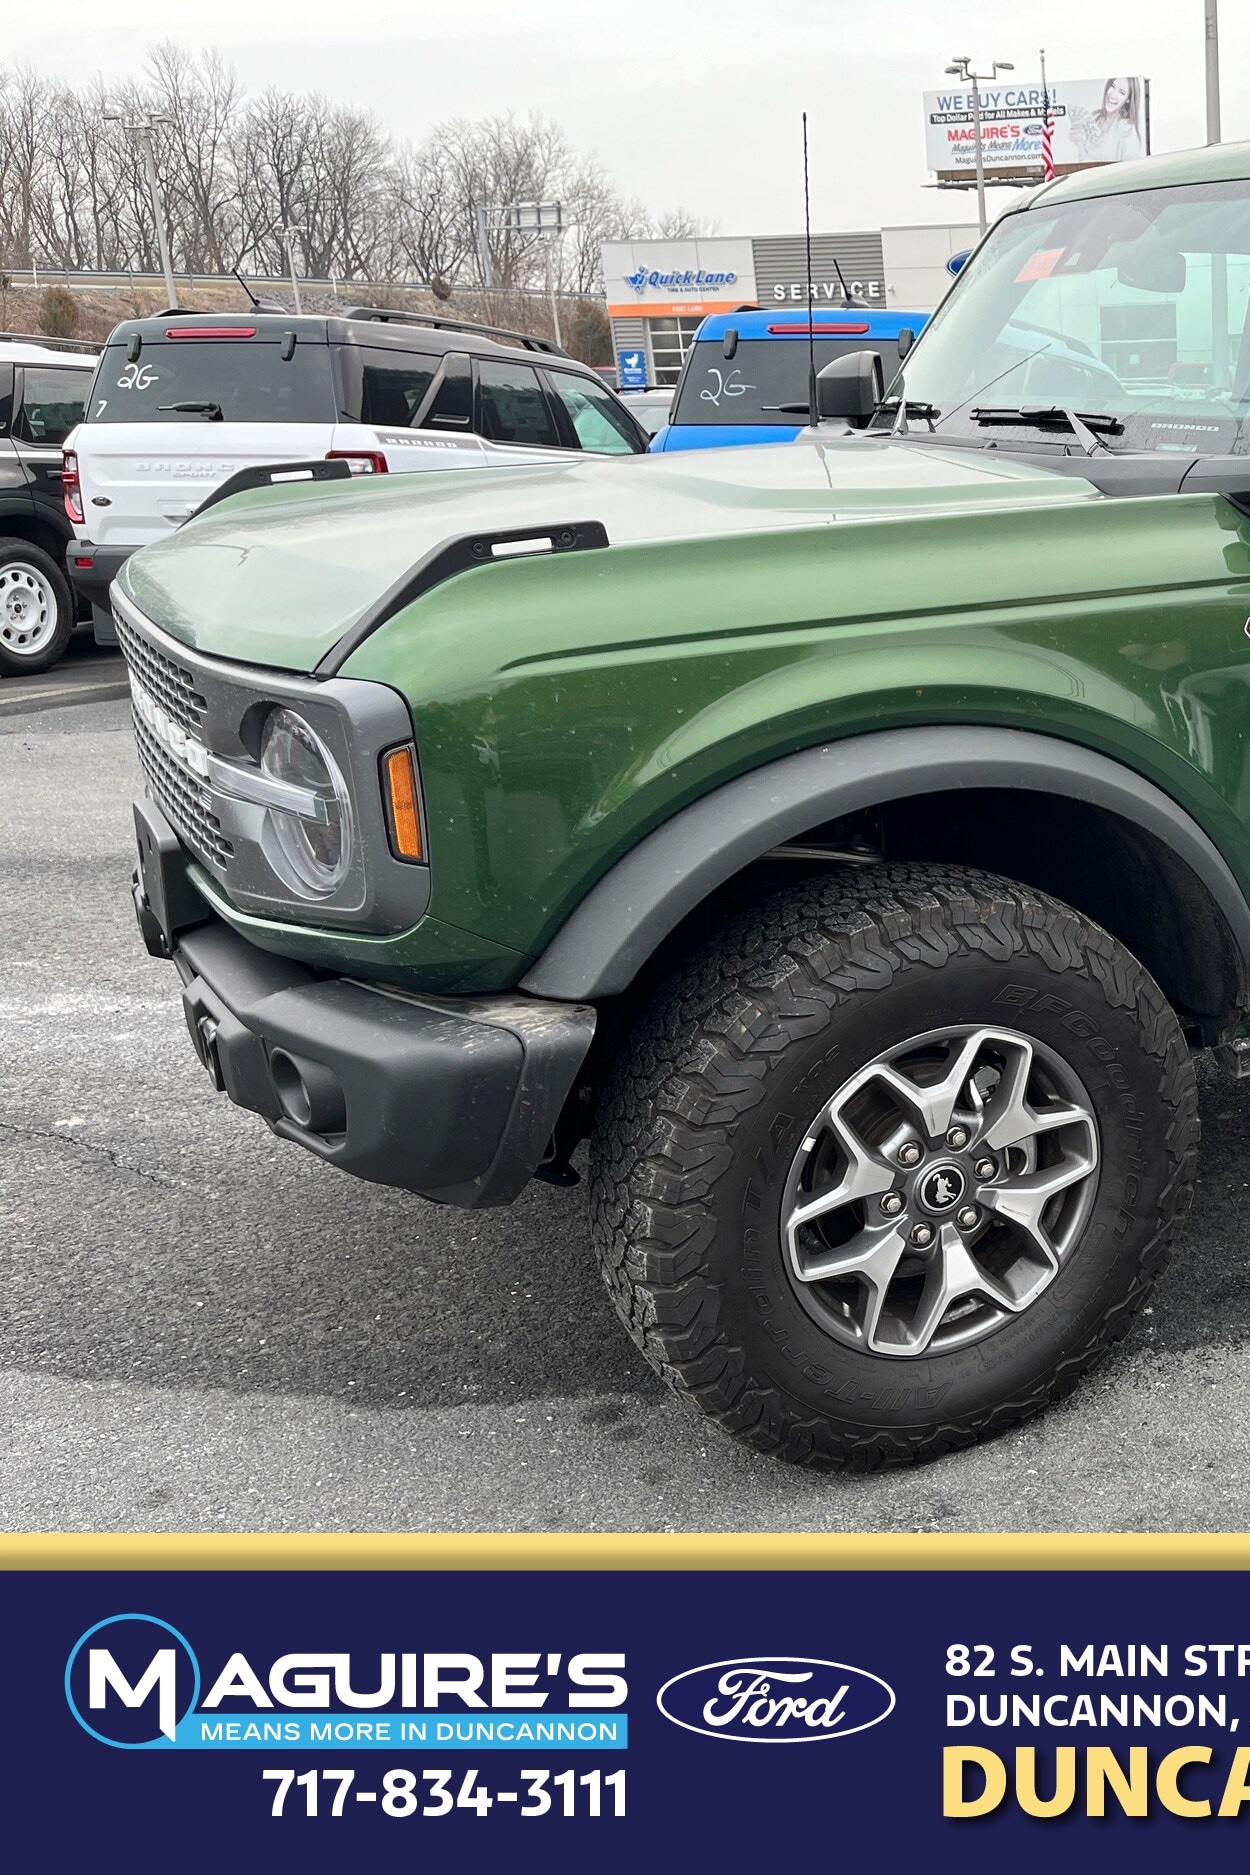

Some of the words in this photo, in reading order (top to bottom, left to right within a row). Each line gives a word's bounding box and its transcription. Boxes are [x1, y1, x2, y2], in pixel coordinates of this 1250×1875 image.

[937, 95, 963, 111] WE
[932, 114, 946, 124] Top
[946, 113, 967, 122] Dollar
[985, 111, 995, 120] for
[995, 110, 1006, 119] All
[1006, 108, 1030, 118] Makes
[1030, 108, 1036, 117] &
[988, 140, 1012, 150] Means
[648, 271, 695, 287] Quick
[695, 270, 736, 284] Lane
[773, 281, 880, 300] SERVICE
[1150, 423, 1220, 432] BRONCO
[135, 462, 253, 472] BRONC
[991, 982, 1148, 1244] BFGoodrich
